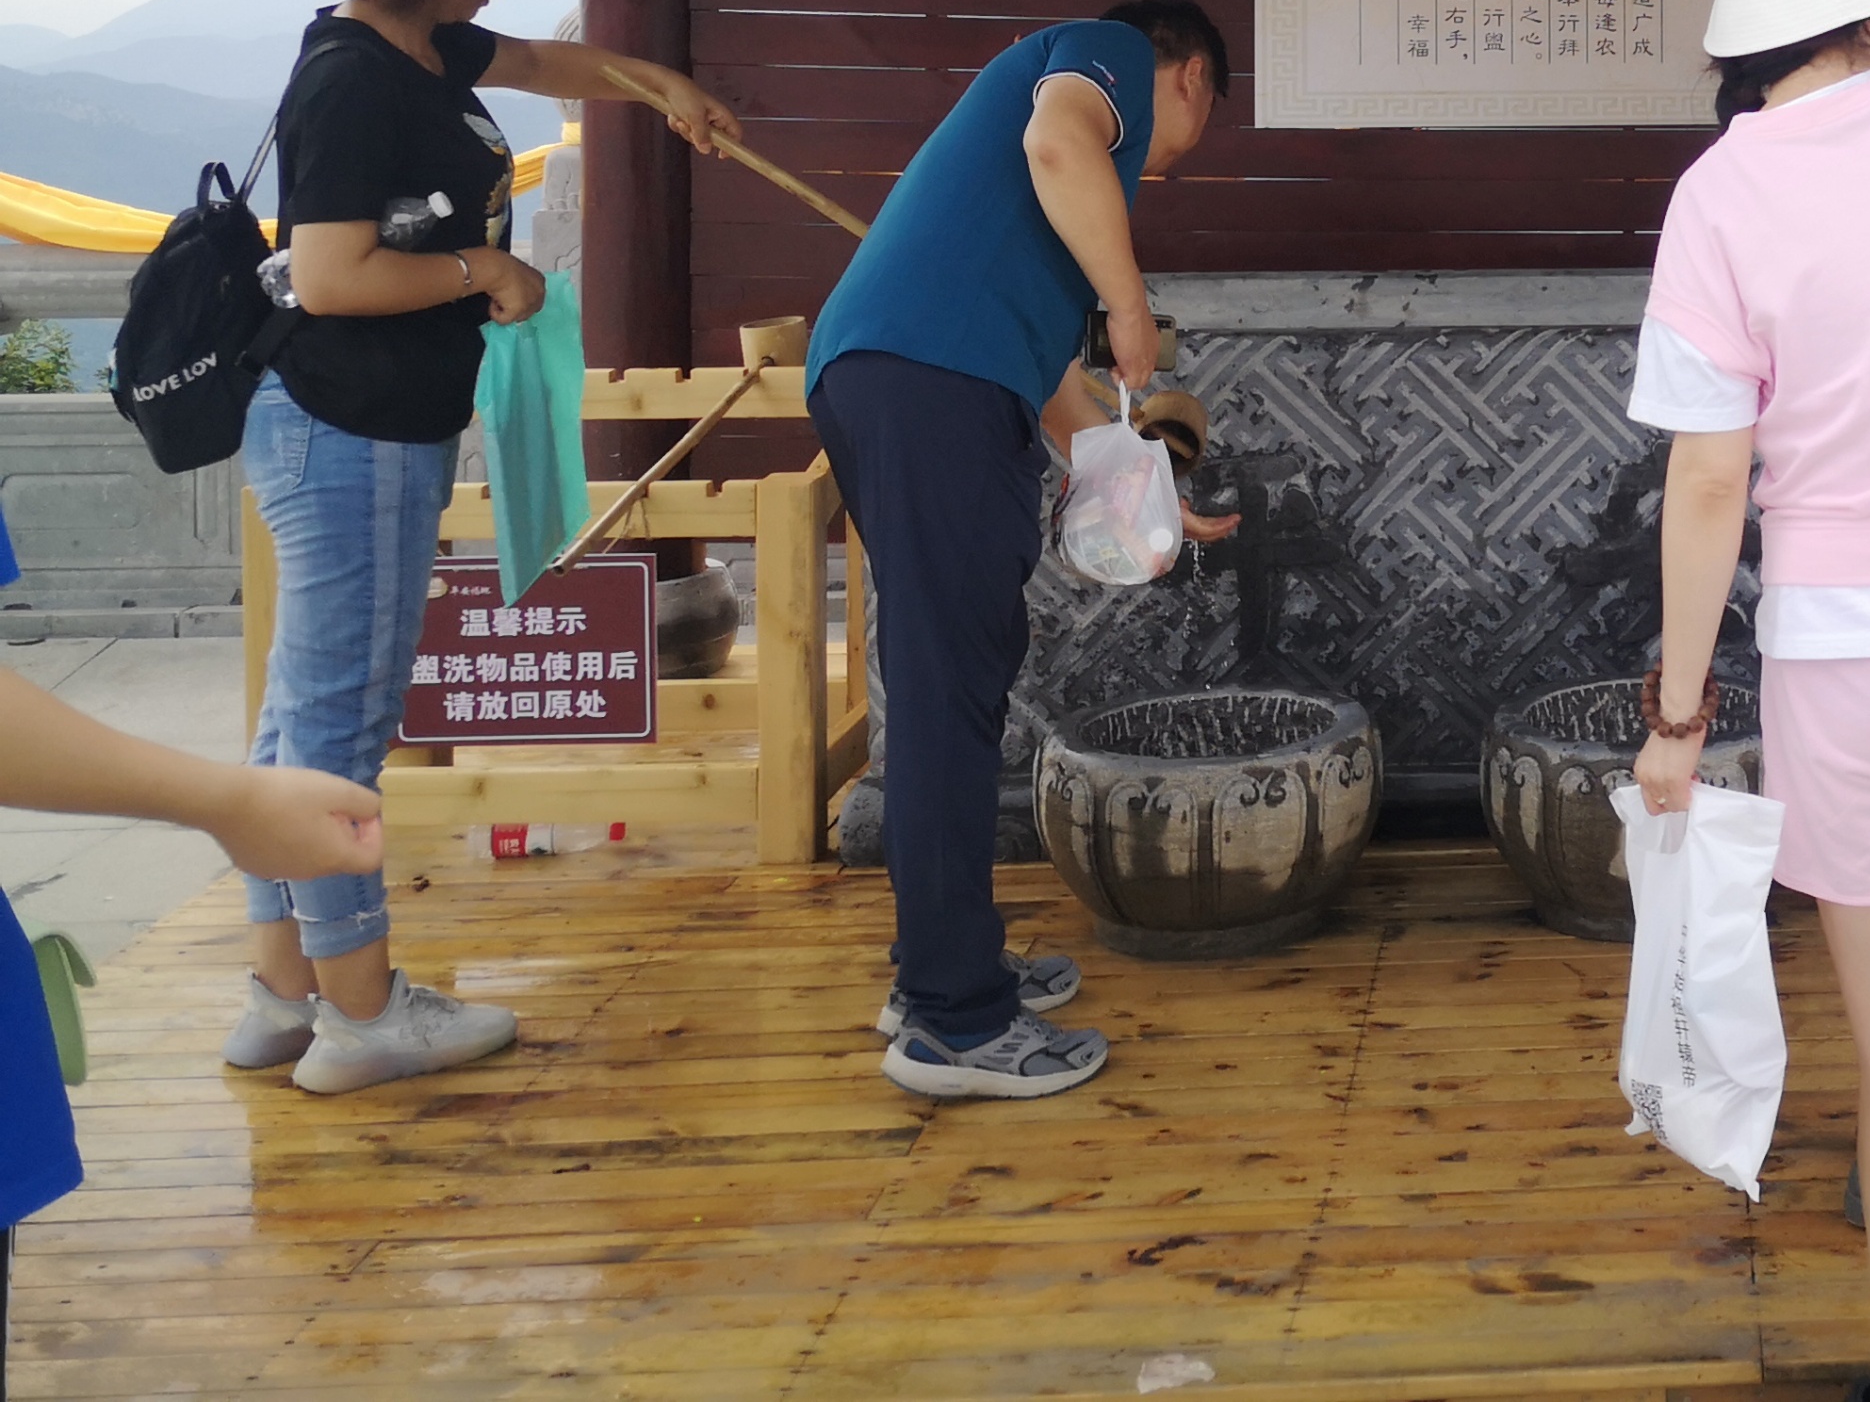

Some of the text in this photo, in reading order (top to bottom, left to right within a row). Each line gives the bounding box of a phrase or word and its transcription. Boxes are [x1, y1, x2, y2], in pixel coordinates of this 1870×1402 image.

[132, 373, 182, 402] LOVE
[459, 606, 587, 637] 温馨提示
[410, 650, 639, 685] 盥洗物品使用后
[443, 689, 608, 722] 请放回原处
